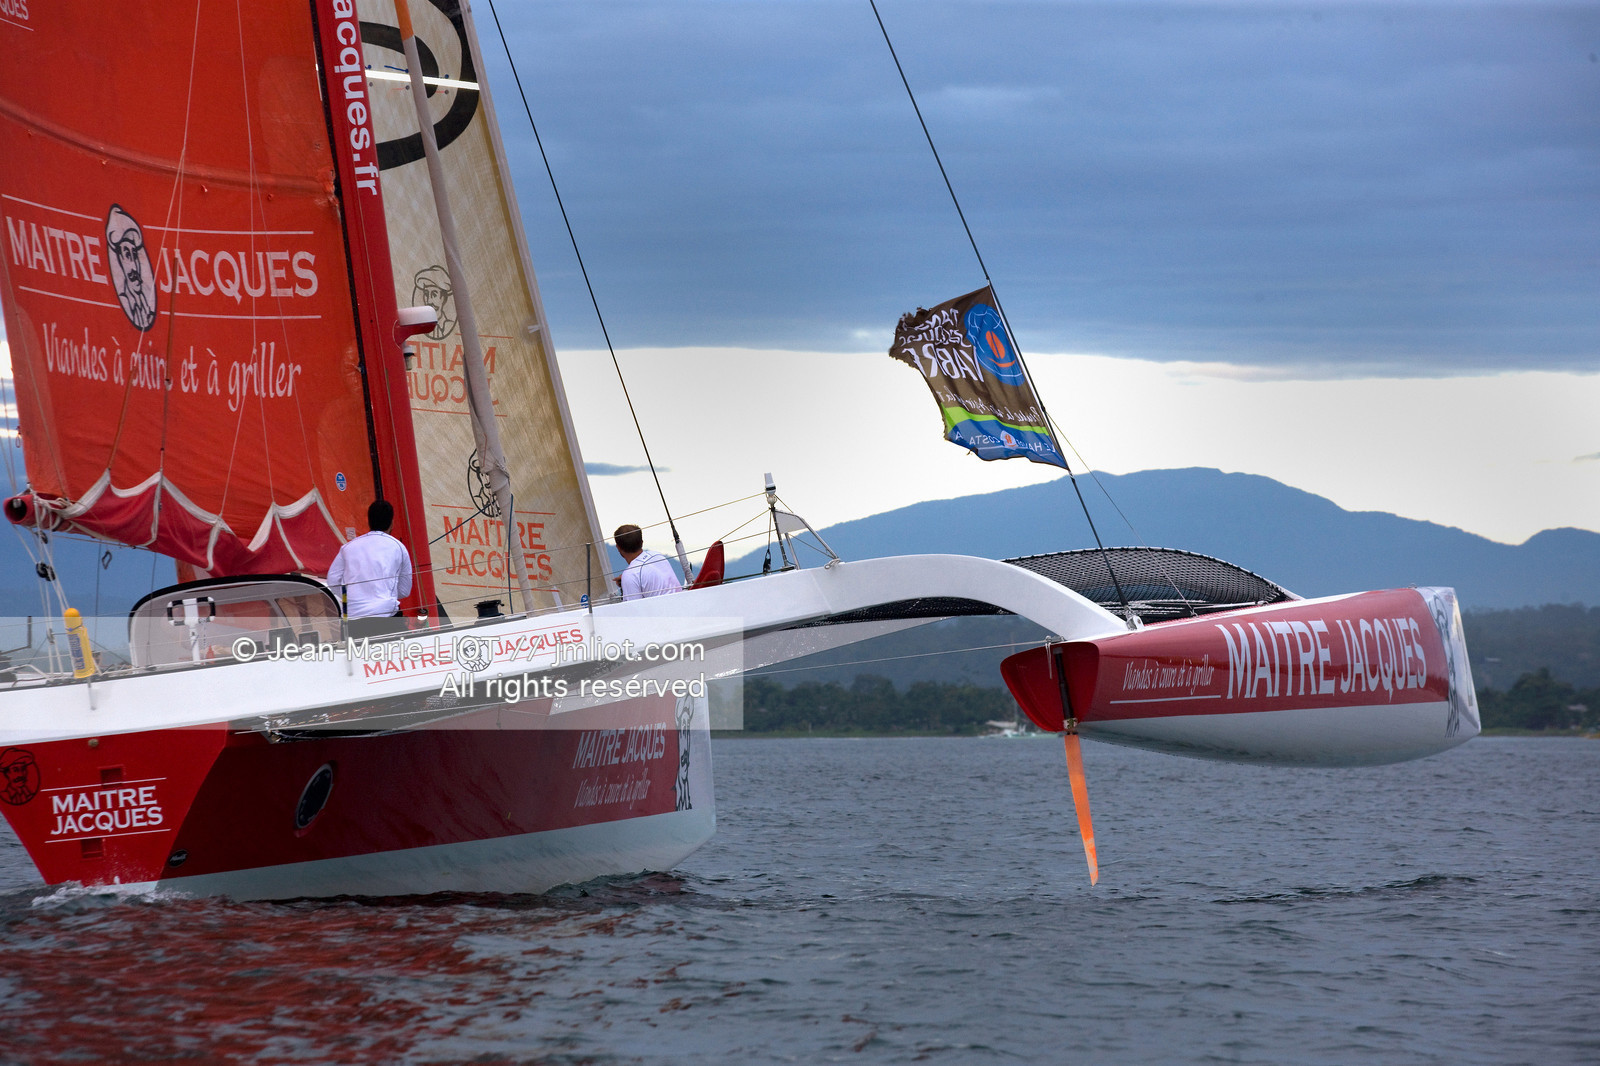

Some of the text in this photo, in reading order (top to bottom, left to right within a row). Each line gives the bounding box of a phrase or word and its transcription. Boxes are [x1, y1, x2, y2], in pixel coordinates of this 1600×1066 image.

[5, 216, 319, 304] MAITRE JACQUES
[43, 322, 108, 382] Viandes
[111, 336, 124, 386] à
[180, 345, 200, 393] et
[206, 348, 220, 396] à
[228, 341, 302, 412] griller
[1215, 617, 1428, 701] MAITRE JACQUES
[572, 722, 667, 769] MAITRE JACQUES
[50, 806, 164, 836] JACQUES
[51, 785, 158, 815] MAITRE
